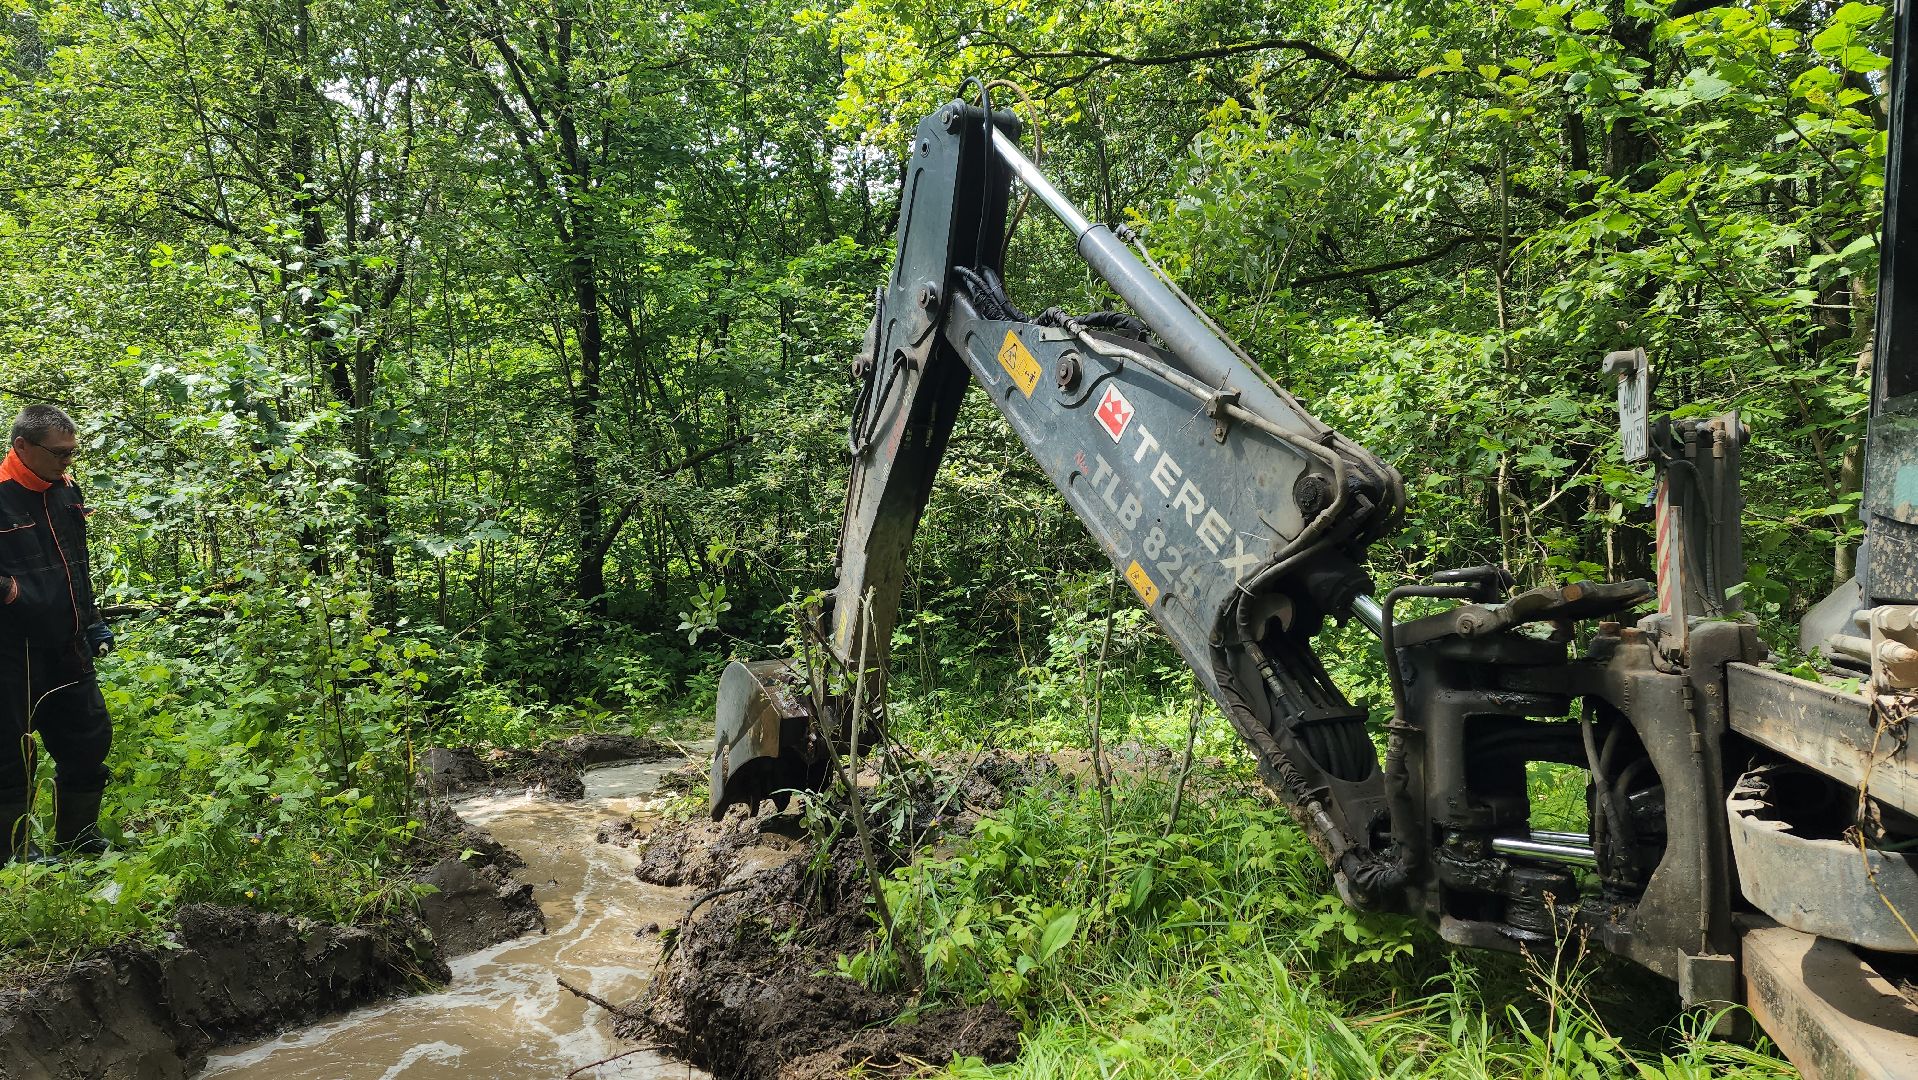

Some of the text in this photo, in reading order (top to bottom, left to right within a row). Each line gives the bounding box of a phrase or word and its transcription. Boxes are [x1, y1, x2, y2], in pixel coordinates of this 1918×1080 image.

[1088, 455, 1200, 600] TLB 825
[1133, 425, 1260, 586] TEREX
